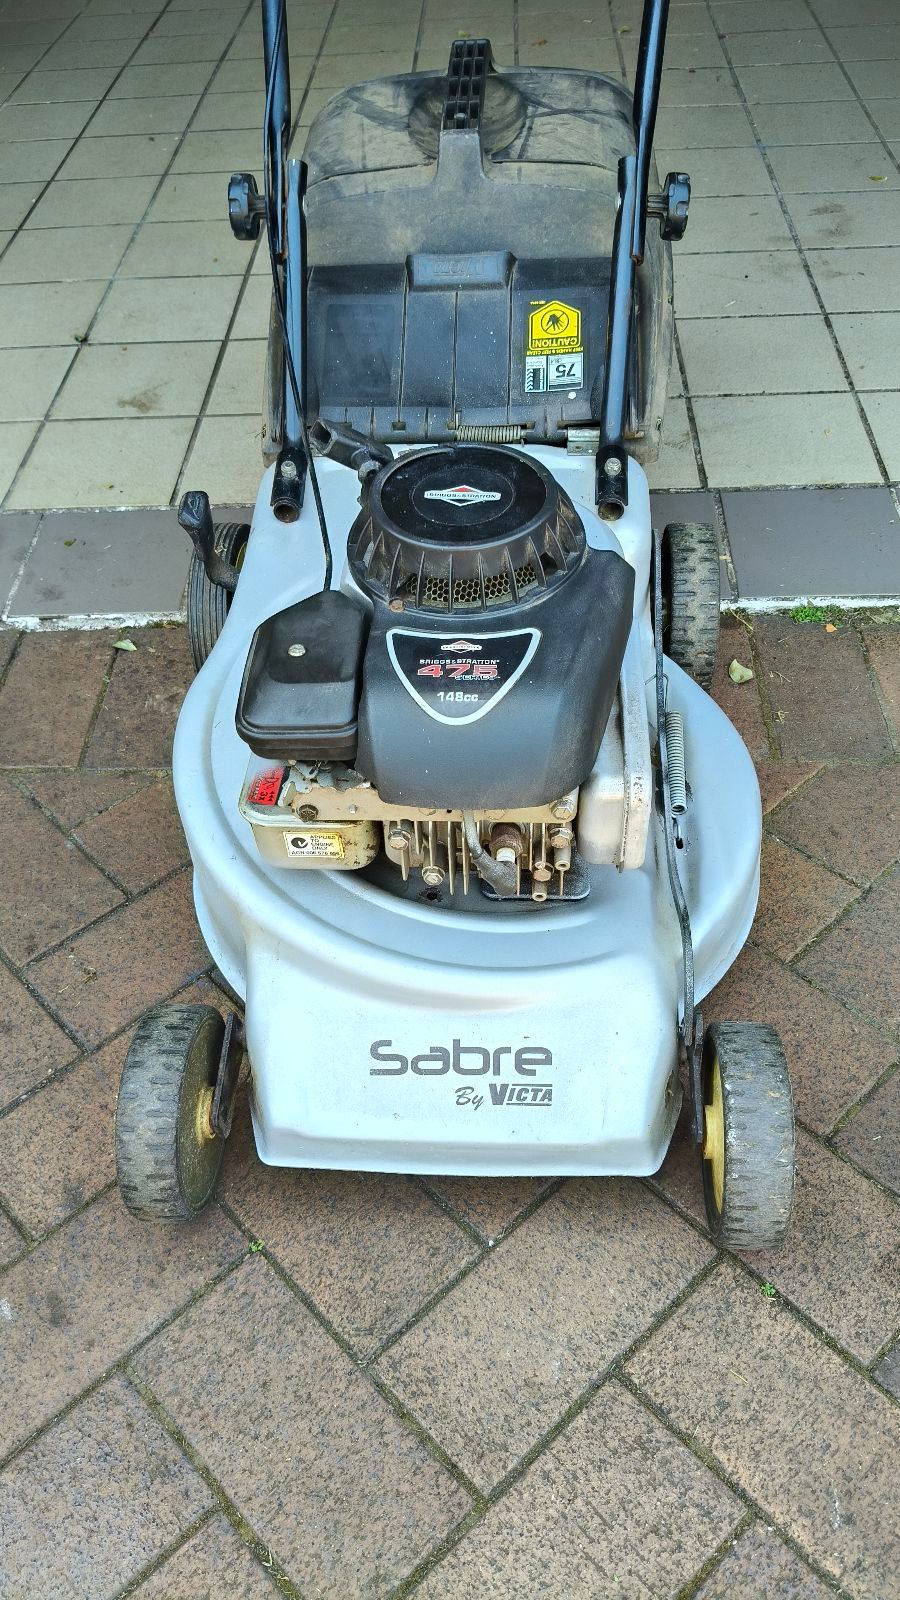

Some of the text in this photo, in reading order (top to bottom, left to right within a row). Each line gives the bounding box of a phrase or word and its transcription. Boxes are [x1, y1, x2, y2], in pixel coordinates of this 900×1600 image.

[532, 337, 578, 348] CAUTION!
[555, 362, 576, 378] 75
[417, 664, 498, 678] 475
[436, 691, 479, 702] 148cc
[369, 1038, 553, 1077] Sabre
[454, 1083, 553, 1111] By VICTA
